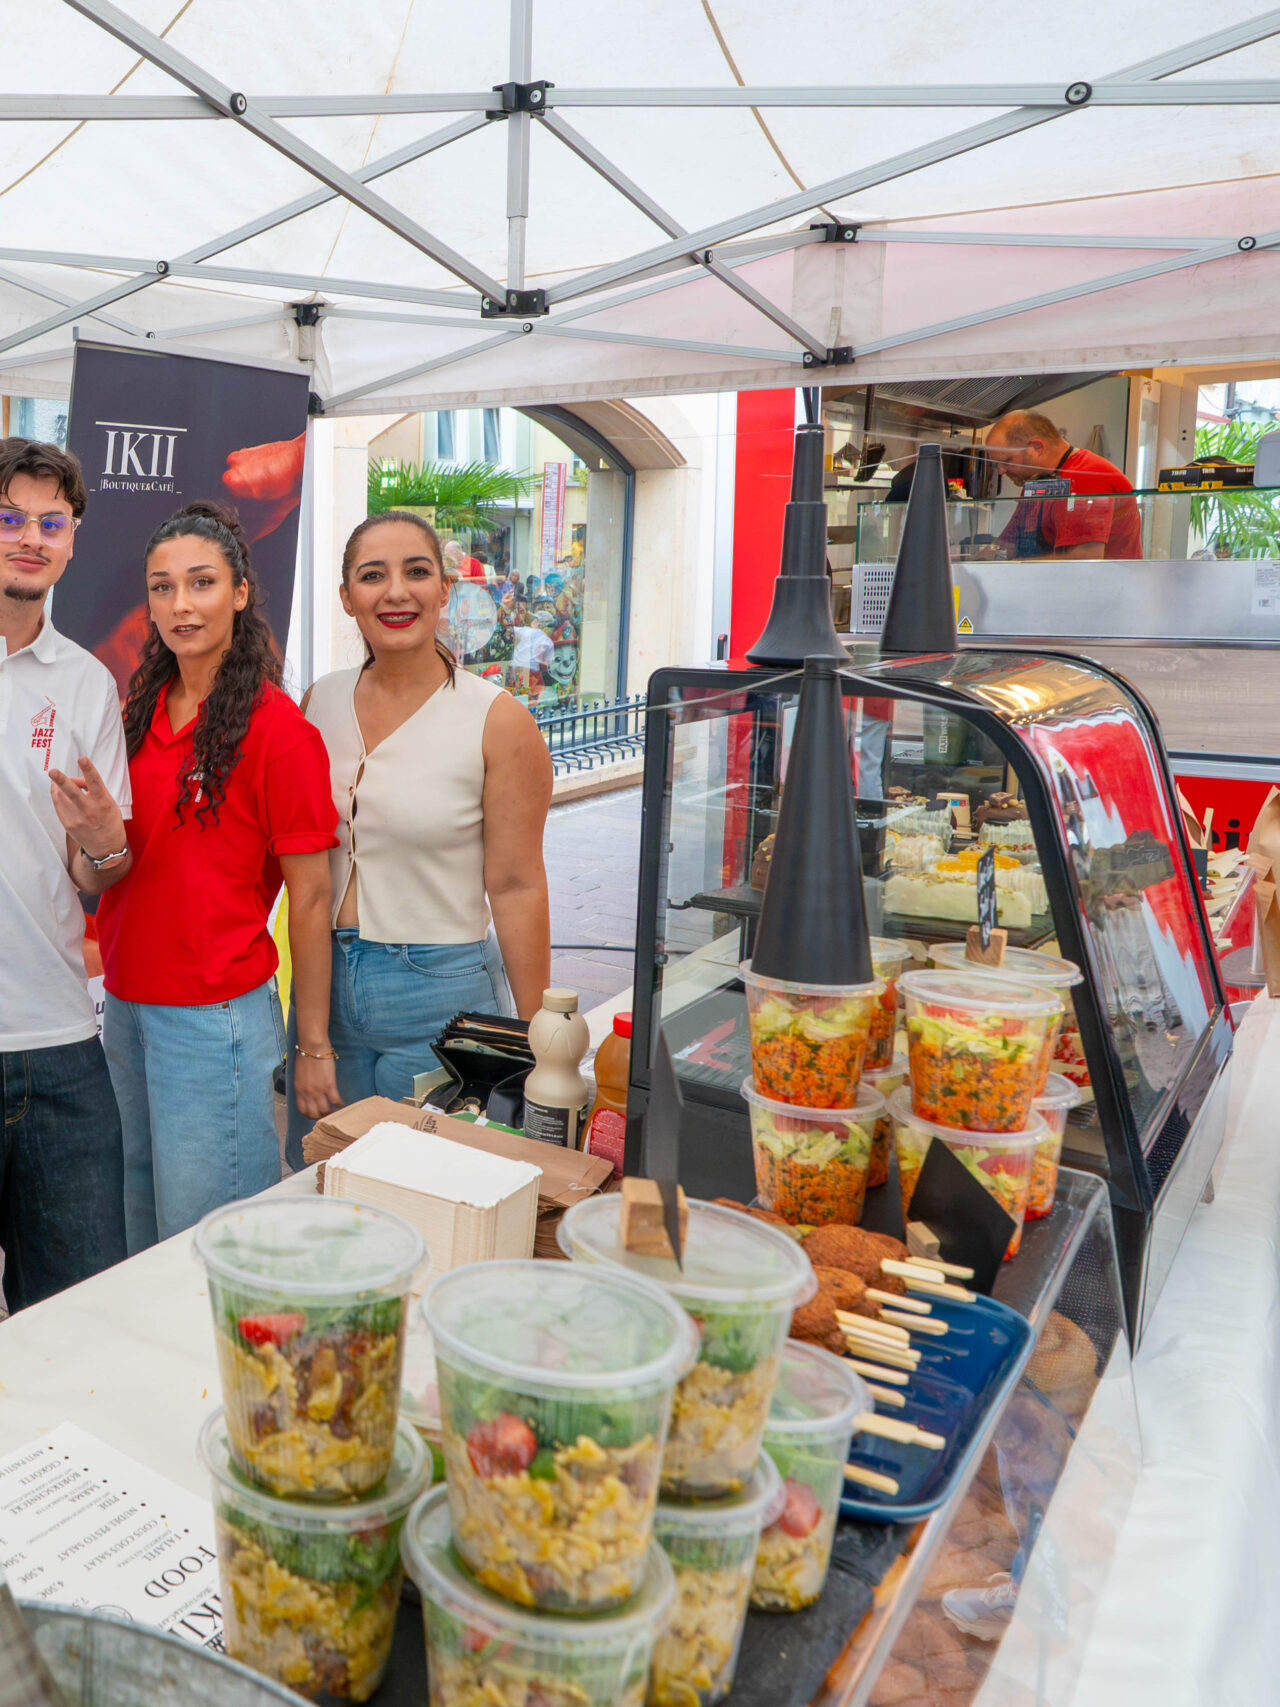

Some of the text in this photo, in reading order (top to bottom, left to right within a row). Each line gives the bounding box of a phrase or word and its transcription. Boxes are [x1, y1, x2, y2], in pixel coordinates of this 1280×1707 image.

[101, 430, 178, 478] IKII
[31, 728, 55, 738] JAZZ
[31, 738, 52, 748] FEST
[68, 1483, 99, 1503] SARMA
[96, 1494, 118, 1510] PIDE
[106, 1505, 138, 1527] NUDEL
[81, 1523, 110, 1544] PESTO
[132, 1517, 157, 1539] COUS
[55, 1540, 85, 1561] SALAT
[109, 1533, 134, 1554] COUS
[141, 1532, 181, 1564] FALAFEL
[83, 1548, 111, 1572] SALAT
[144, 1545, 217, 1598] FOOD
